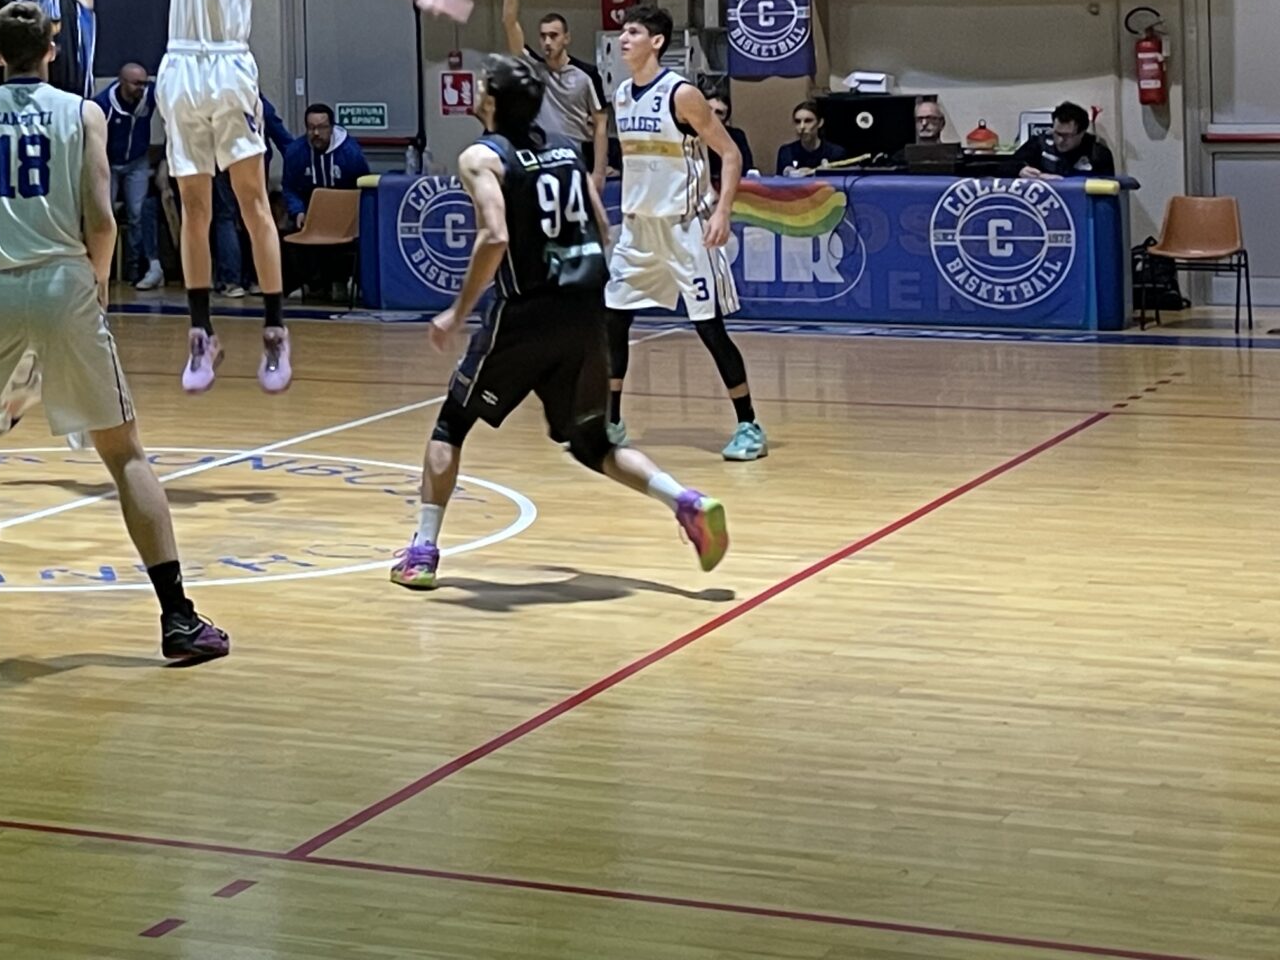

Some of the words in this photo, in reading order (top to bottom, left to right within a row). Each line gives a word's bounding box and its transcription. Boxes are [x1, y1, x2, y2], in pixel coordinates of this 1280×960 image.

[758, 0, 775, 27] C
[730, 27, 806, 57] BASKETBALL
[340, 107, 383, 115] APERTURA
[355, 116, 381, 125] SPINTA
[652, 96, 662, 113] 3
[408, 176, 462, 211] COLL
[536, 169, 589, 238] 94
[943, 178, 1060, 217] COLLEGE
[445, 213, 466, 248] C
[987, 219, 1013, 257] C
[693, 277, 710, 302] 3
[946, 257, 1063, 303] BASKETBALL
